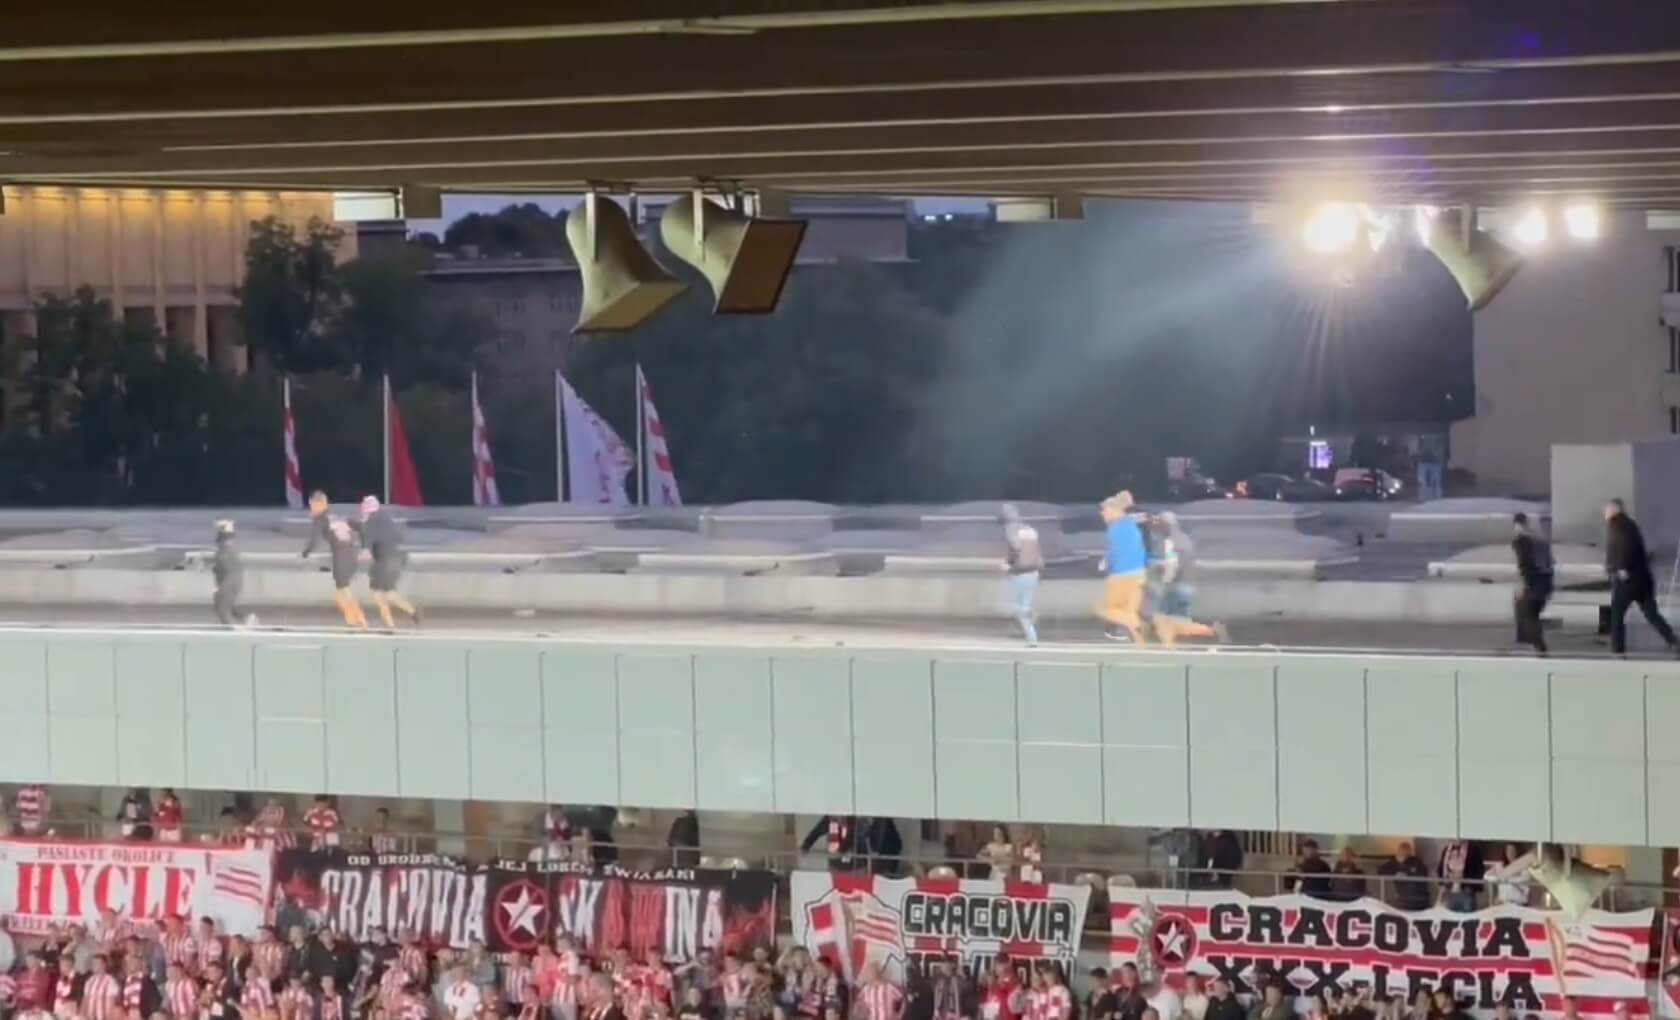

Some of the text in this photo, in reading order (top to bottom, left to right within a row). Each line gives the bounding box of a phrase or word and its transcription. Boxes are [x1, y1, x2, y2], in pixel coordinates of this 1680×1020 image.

[347, 854, 371, 865] OD
[494, 859, 527, 872] JEJ
[16, 862, 195, 922] HYCLE
[320, 868, 724, 964] CRACOVIA SKAWINA
[904, 894, 1072, 944] CRACOVIA
[1209, 903, 1531, 957] CRACOVIA
[1206, 955, 1543, 1009] XXX-LECIA
